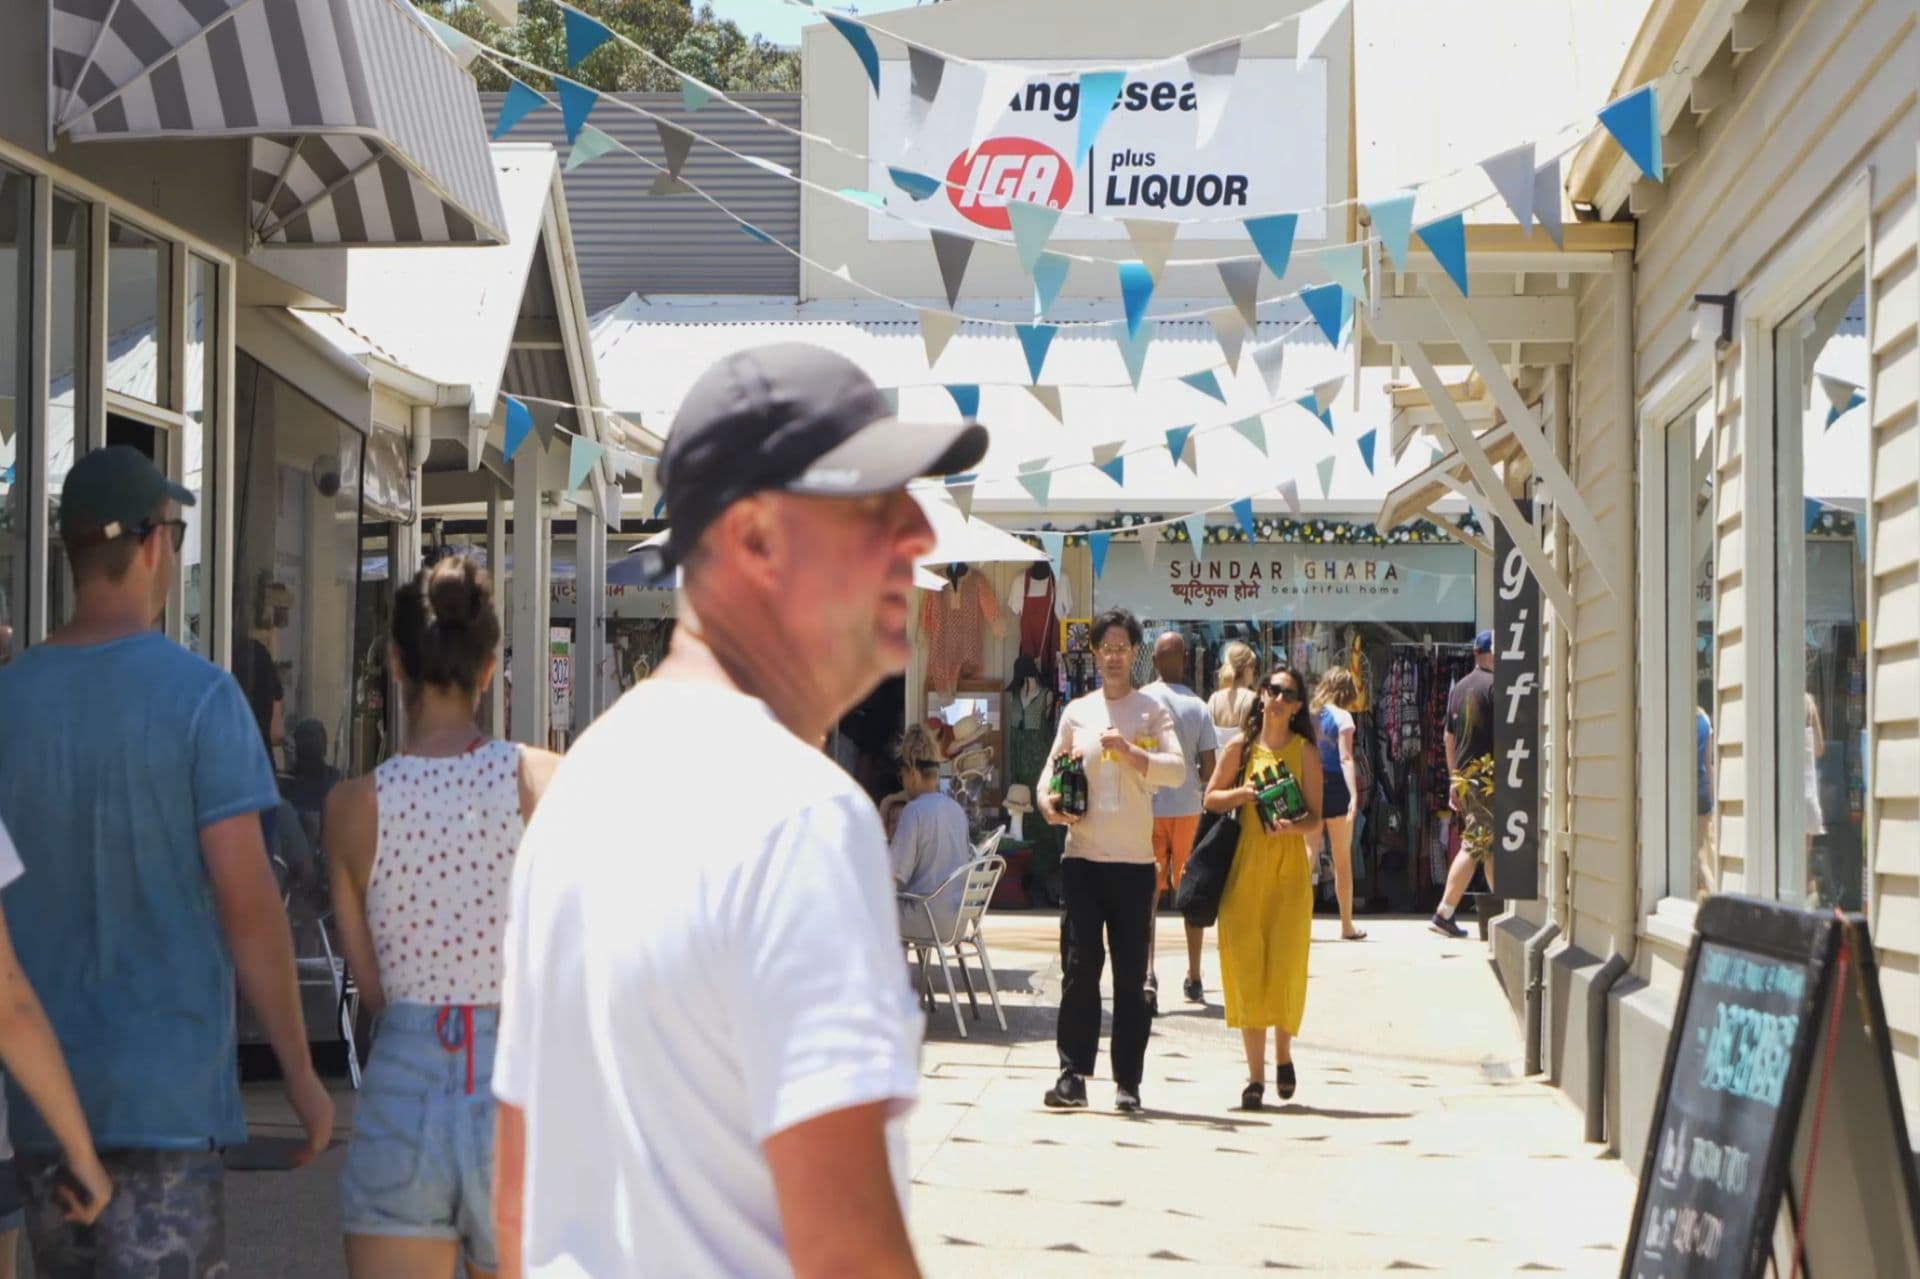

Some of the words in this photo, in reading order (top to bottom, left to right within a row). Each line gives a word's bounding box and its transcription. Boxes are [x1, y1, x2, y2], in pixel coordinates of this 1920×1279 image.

[1008, 81, 1198, 121] ngsea
[1111, 148, 1156, 171] plus
[959, 154, 1060, 208] IGA
[1105, 174, 1249, 209] LIQUOR
[1170, 560, 1283, 580] SUNDAR
[1304, 560, 1399, 581] GHARA
[1271, 585, 1350, 594] beautiful
[1359, 585, 1399, 594] home
[1499, 546, 1535, 853] gifts
